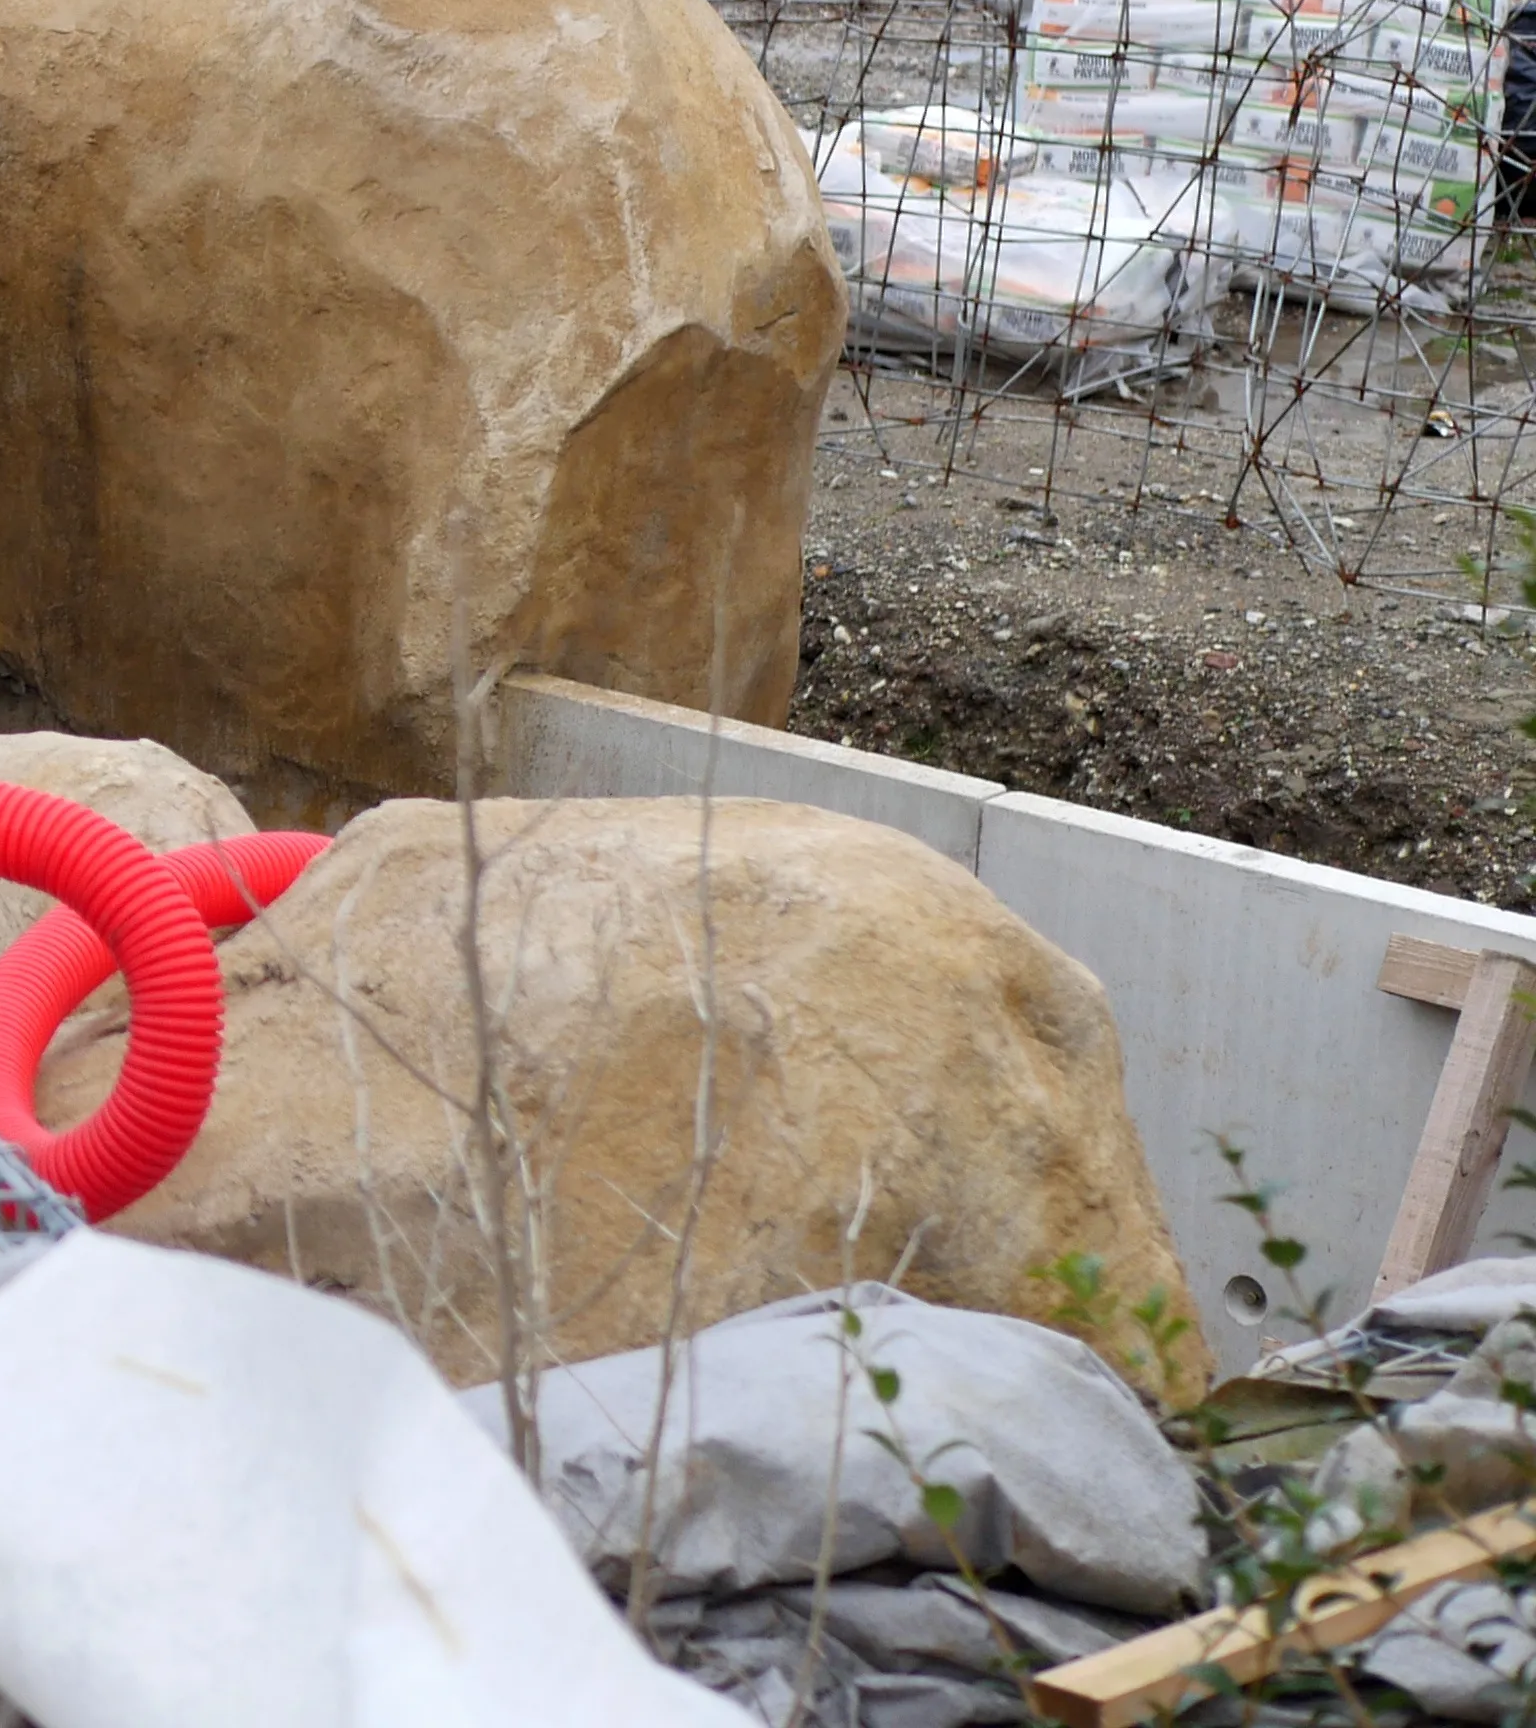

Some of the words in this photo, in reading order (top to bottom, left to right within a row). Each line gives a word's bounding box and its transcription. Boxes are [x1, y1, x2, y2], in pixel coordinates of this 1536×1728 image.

[1294, 26, 1343, 41] MORTR
[1077, 52, 1125, 68] MORT
[1073, 67, 1129, 80] PAYSAR
[1069, 161, 1125, 173] PAYSER
